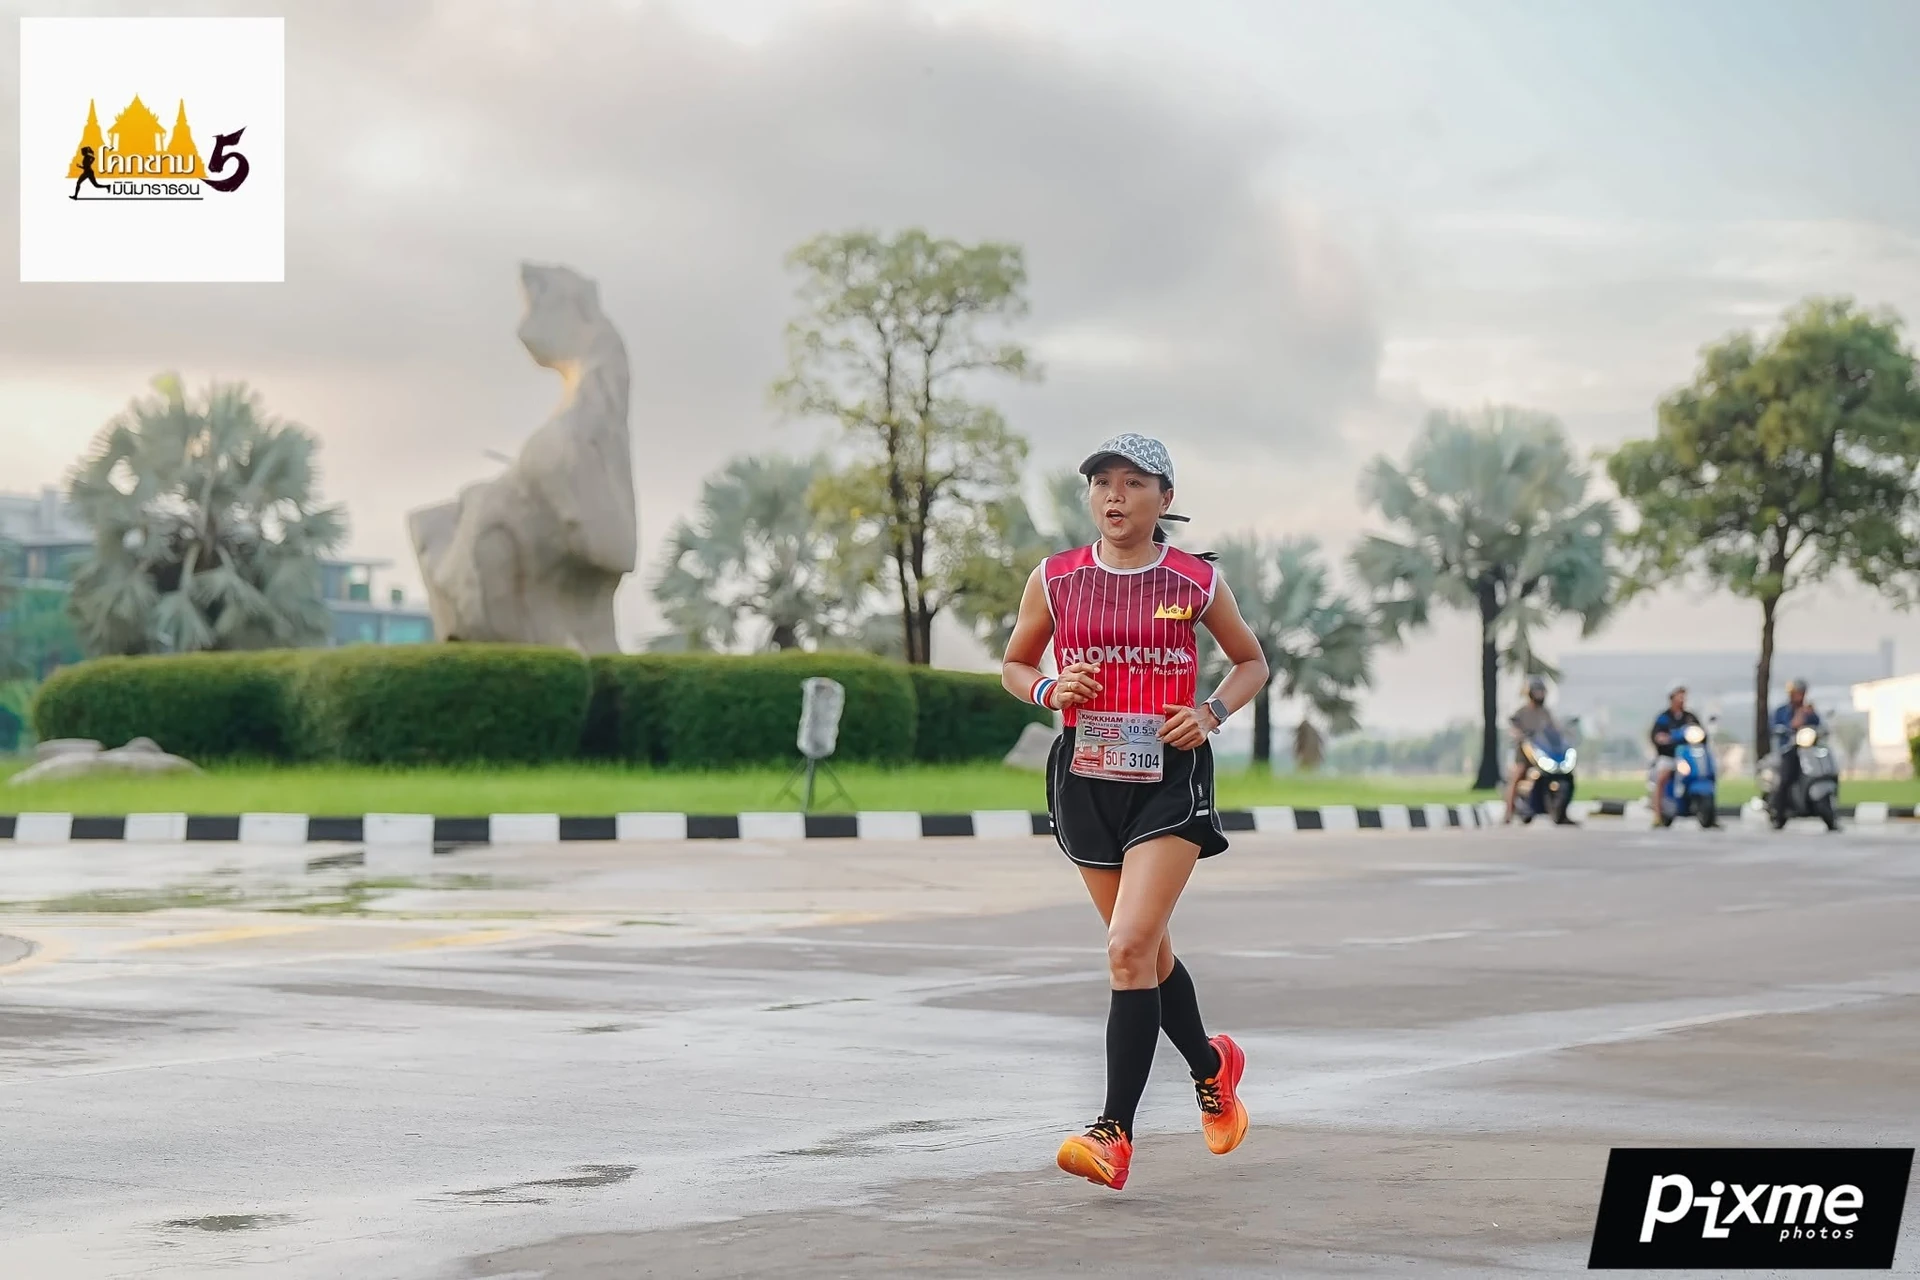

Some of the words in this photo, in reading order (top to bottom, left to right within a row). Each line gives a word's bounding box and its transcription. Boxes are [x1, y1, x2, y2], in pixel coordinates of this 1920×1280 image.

[1128, 725, 1148, 735] 10.5
[1105, 751, 1118, 766] 50
[1119, 752, 1127, 766] F
[1129, 752, 1160, 768] 3104
